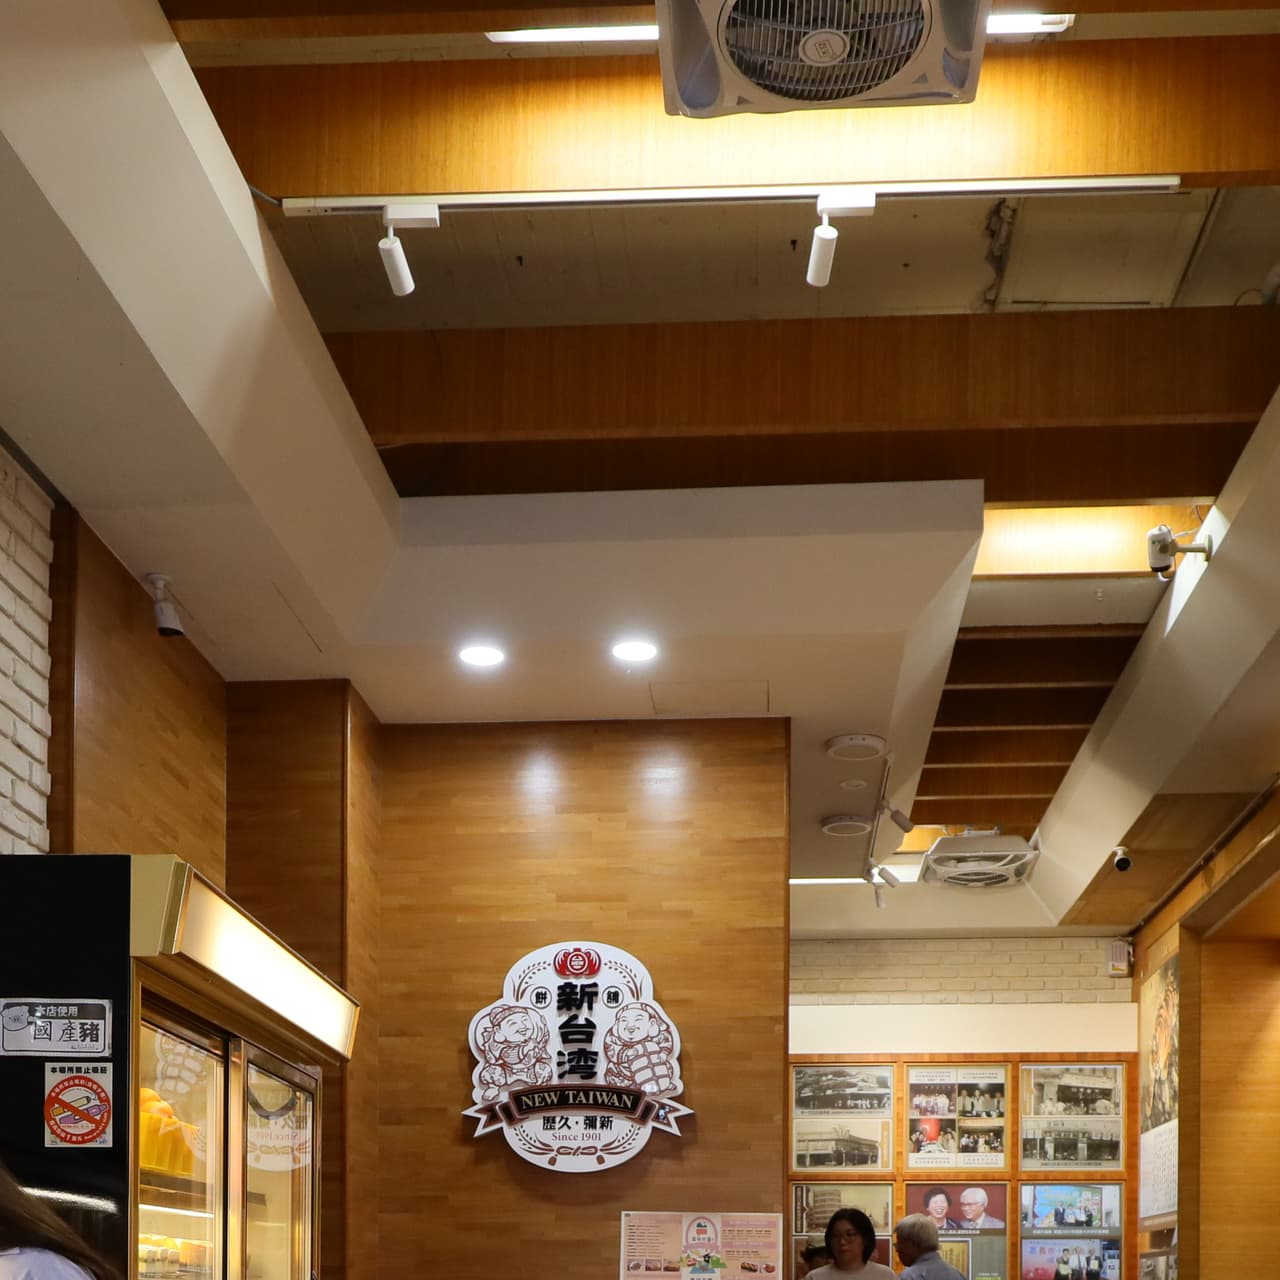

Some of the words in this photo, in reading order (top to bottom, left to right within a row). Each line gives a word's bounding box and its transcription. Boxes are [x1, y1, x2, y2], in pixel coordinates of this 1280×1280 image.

[35, 1006, 78, 1017] 本店使用
[521, 1091, 560, 1109] NEW
[565, 1090, 634, 1108] TAIWAN
[552, 1132, 578, 1141] Since
[581, 1132, 601, 1141] 1901
